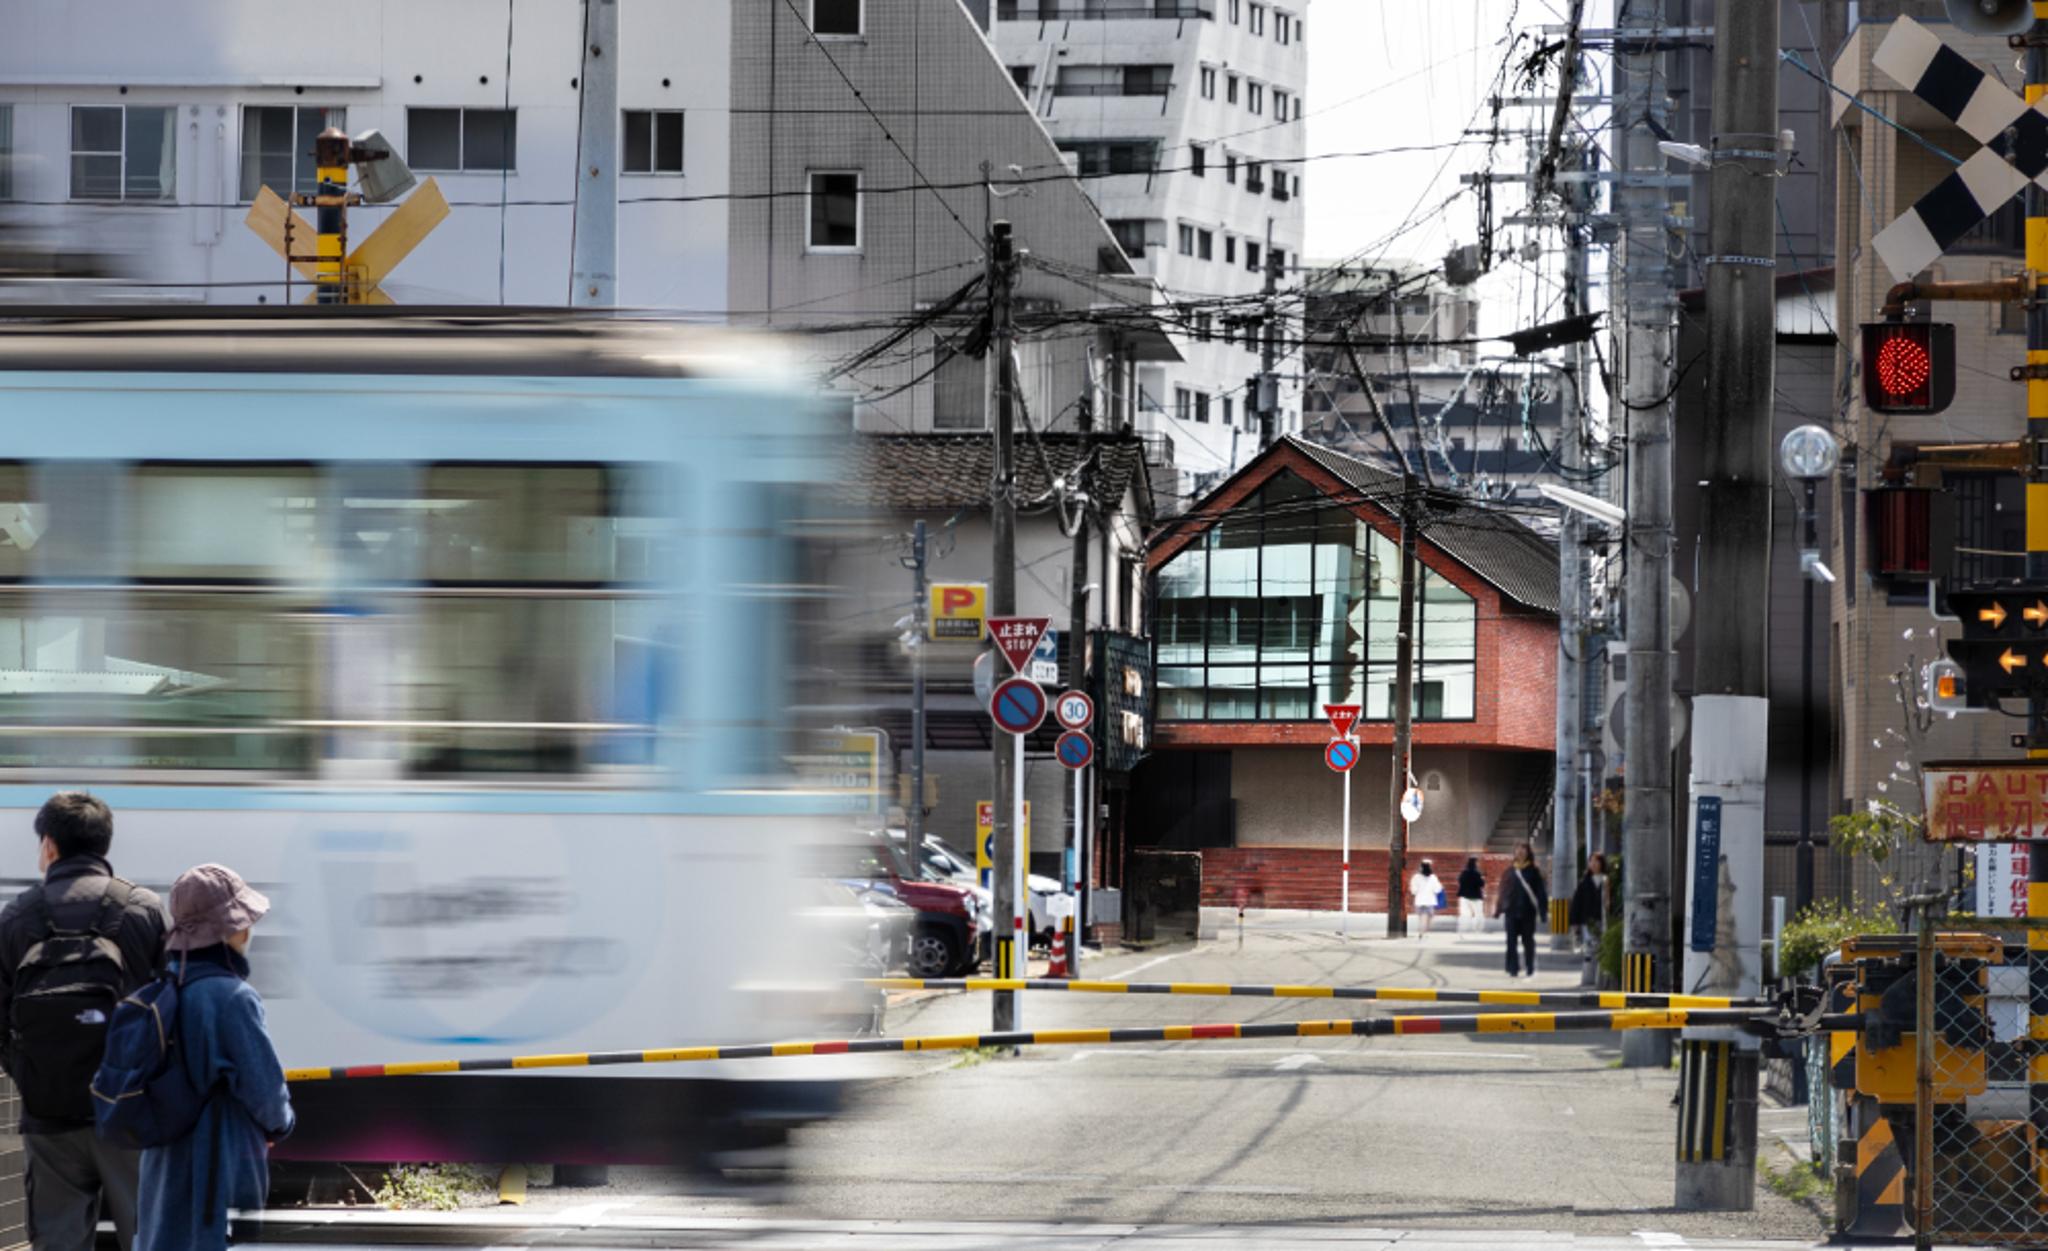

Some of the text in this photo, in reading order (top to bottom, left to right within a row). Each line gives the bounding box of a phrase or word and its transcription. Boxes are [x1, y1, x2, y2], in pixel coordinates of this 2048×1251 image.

[943, 587, 975, 615] P
[999, 622, 1039, 638] 止まれ
[1005, 638, 1033, 651] STOP
[1064, 701, 1087, 720] 30
[1948, 773, 2048, 796] CAUT
